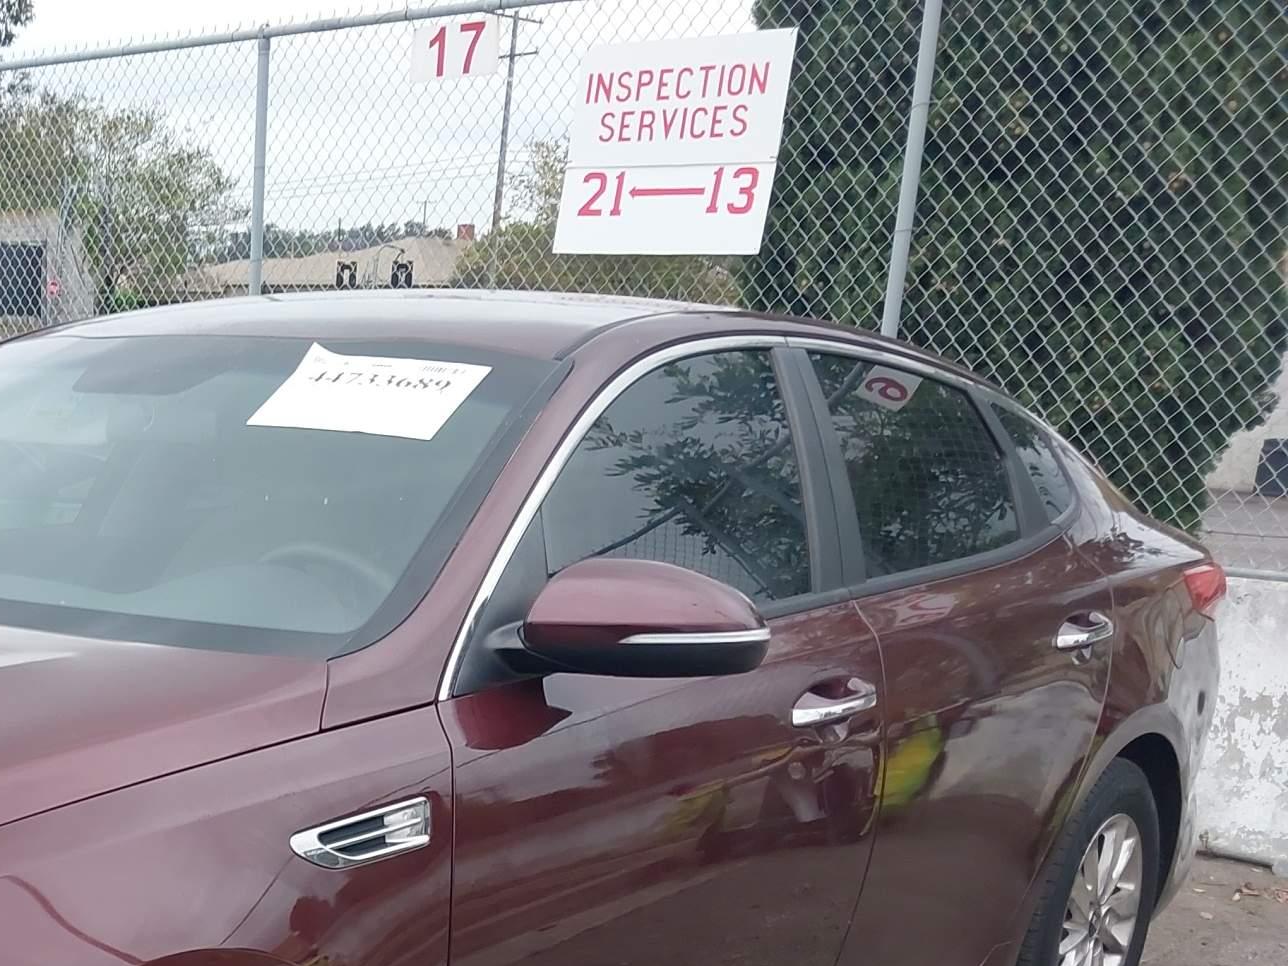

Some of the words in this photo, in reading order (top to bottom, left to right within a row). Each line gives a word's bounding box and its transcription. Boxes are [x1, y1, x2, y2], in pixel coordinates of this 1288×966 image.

[428, 21, 486, 77] 17
[585, 62, 770, 105] INSPECTION
[598, 104, 749, 143] SERVICES
[577, 171, 626, 217] 21
[705, 167, 760, 215] 13
[309, 370, 452, 395] 44733689
